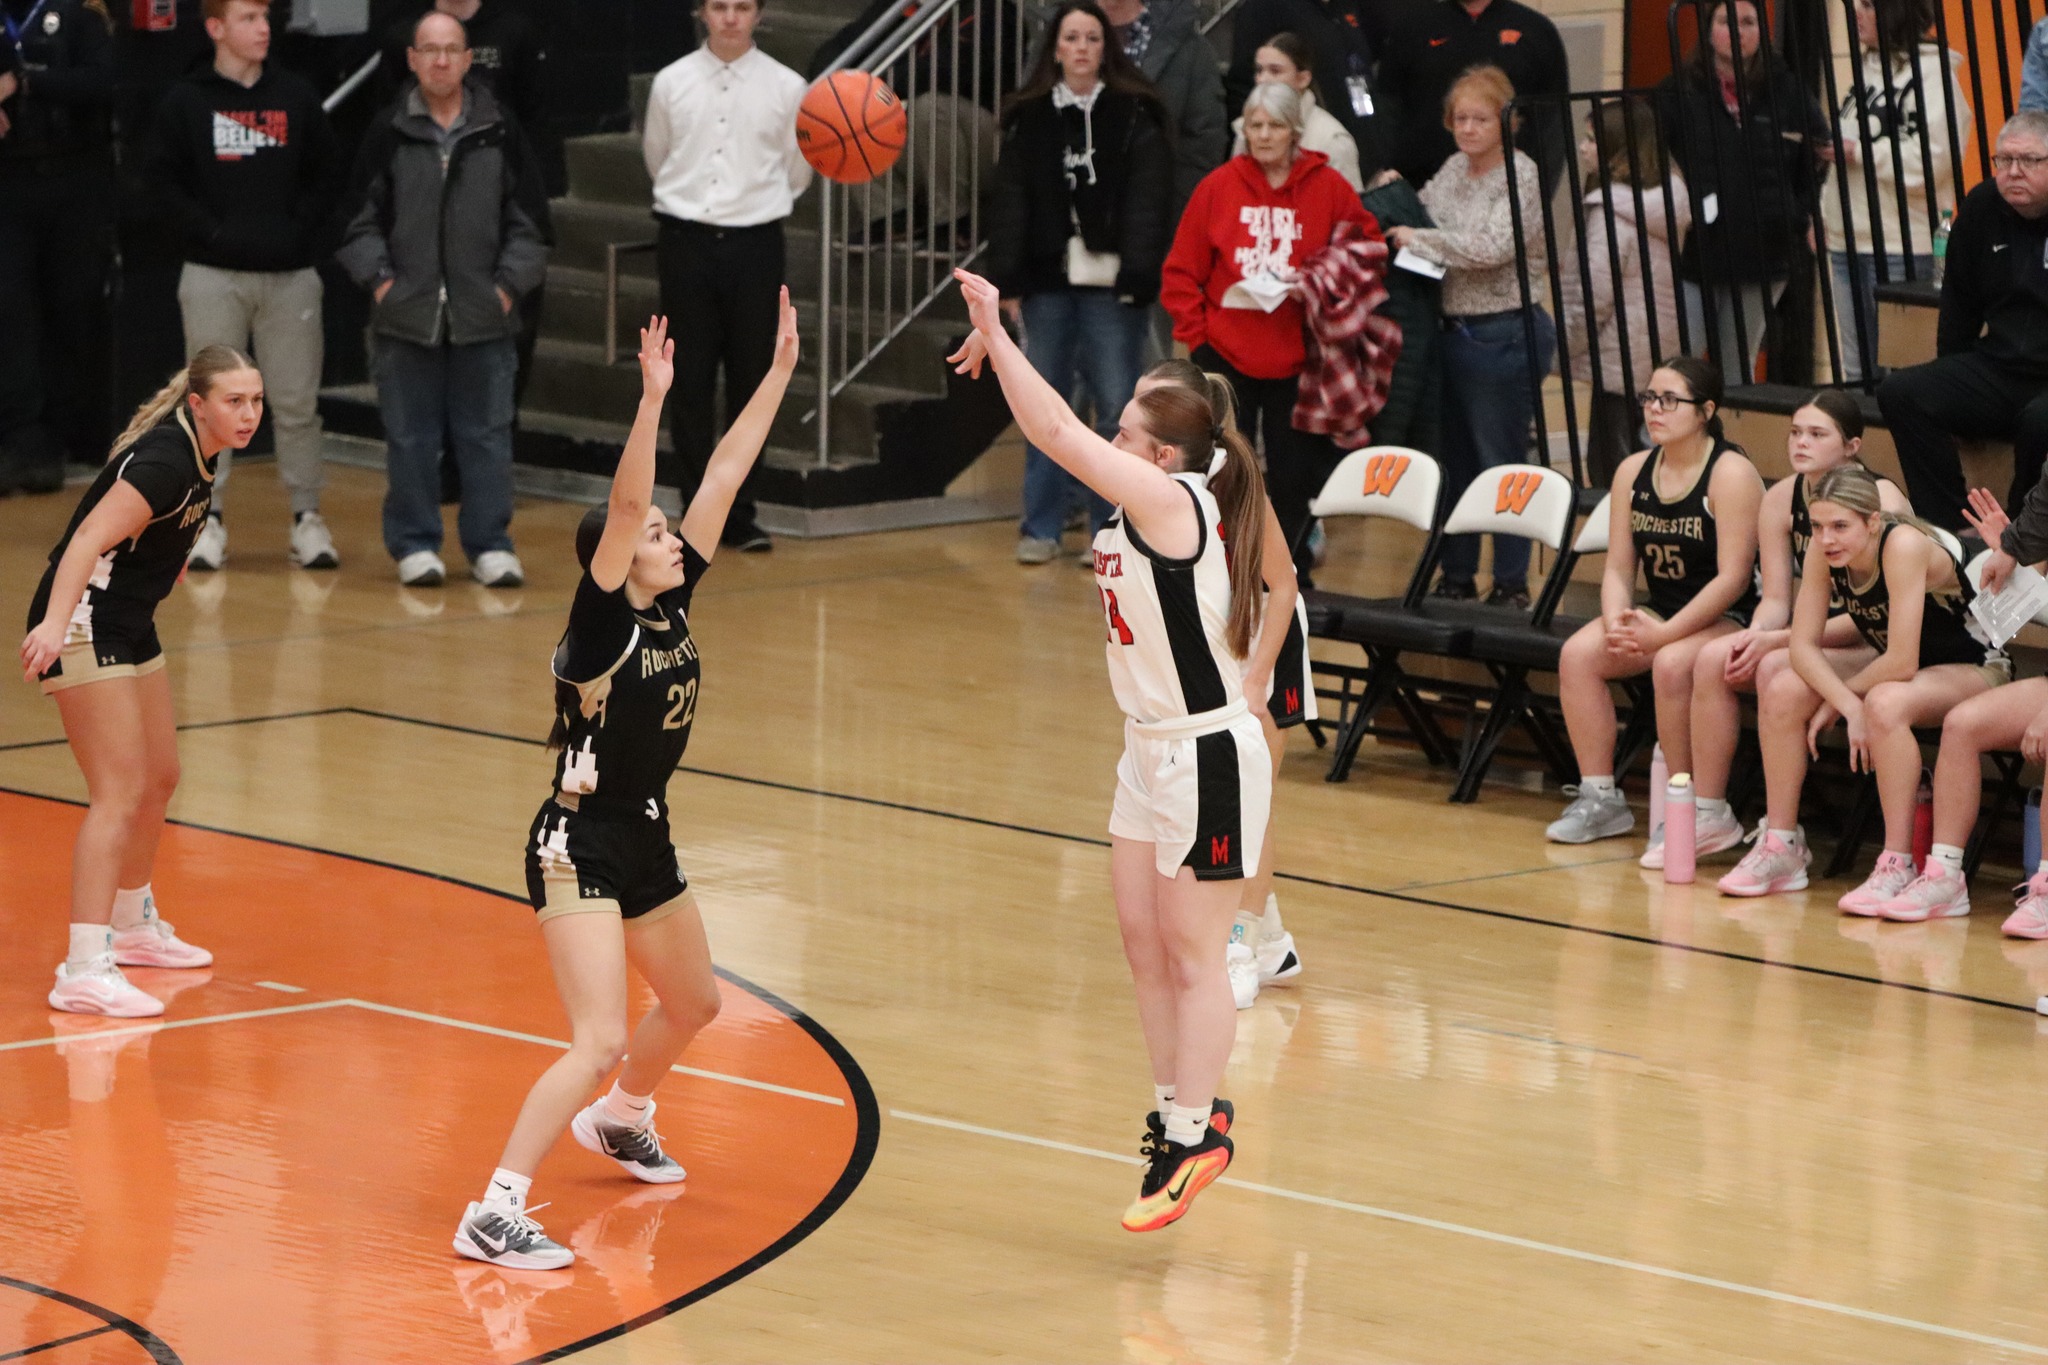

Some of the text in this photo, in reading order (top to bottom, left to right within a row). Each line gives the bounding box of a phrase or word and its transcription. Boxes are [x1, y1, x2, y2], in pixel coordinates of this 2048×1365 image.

[1363, 454, 1411, 497] W
[1495, 472, 1544, 516] W
[1632, 510, 1704, 541] ROCHESTER
[1645, 543, 1686, 579] 25
[662, 677, 697, 731] 22
[1284, 686, 1299, 715] M
[1211, 834, 1229, 866] M
